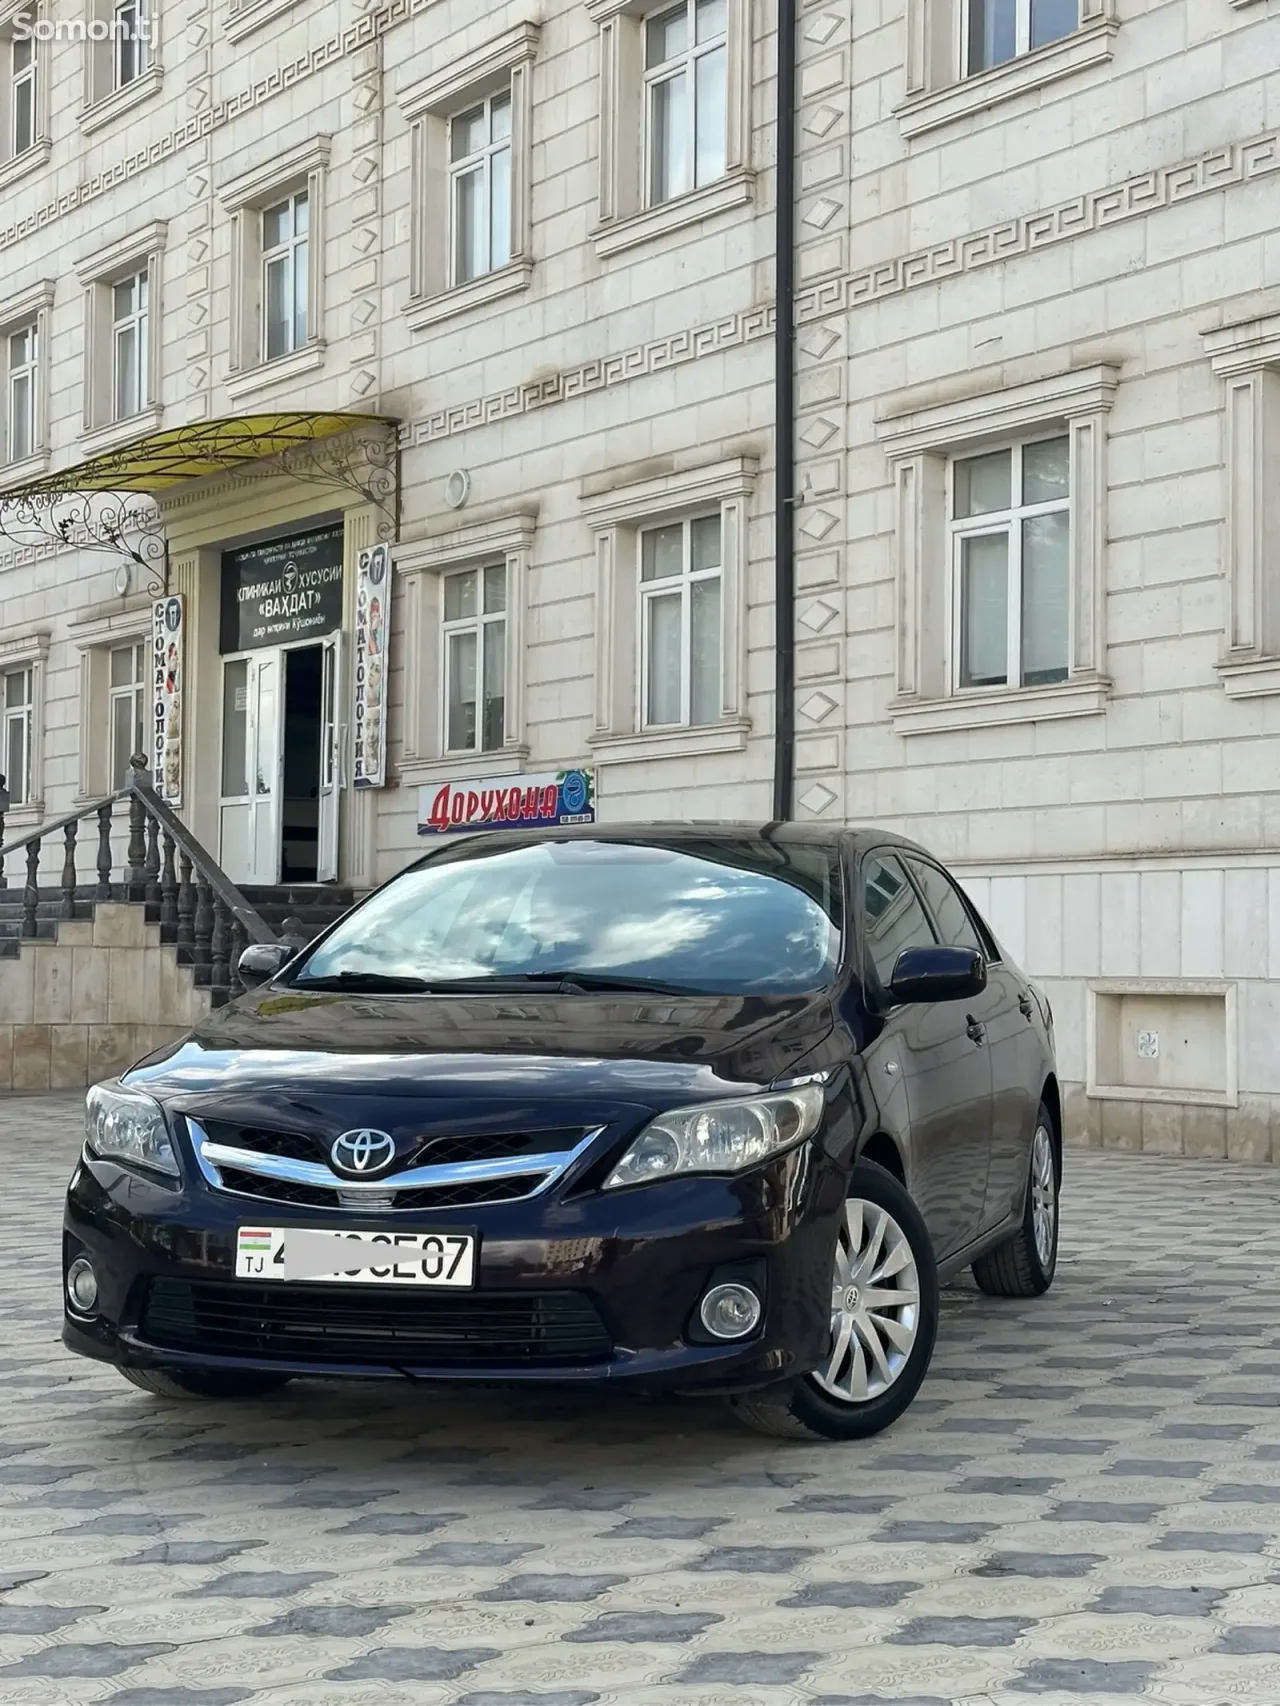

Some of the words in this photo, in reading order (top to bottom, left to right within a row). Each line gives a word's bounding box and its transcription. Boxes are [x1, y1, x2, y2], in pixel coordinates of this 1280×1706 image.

[154, 602, 166, 800] СТОМАТОЛОГИЯ
[354, 551, 369, 778] СТОМАТОЛОГИЯ
[245, 1256, 264, 1273] TJ
